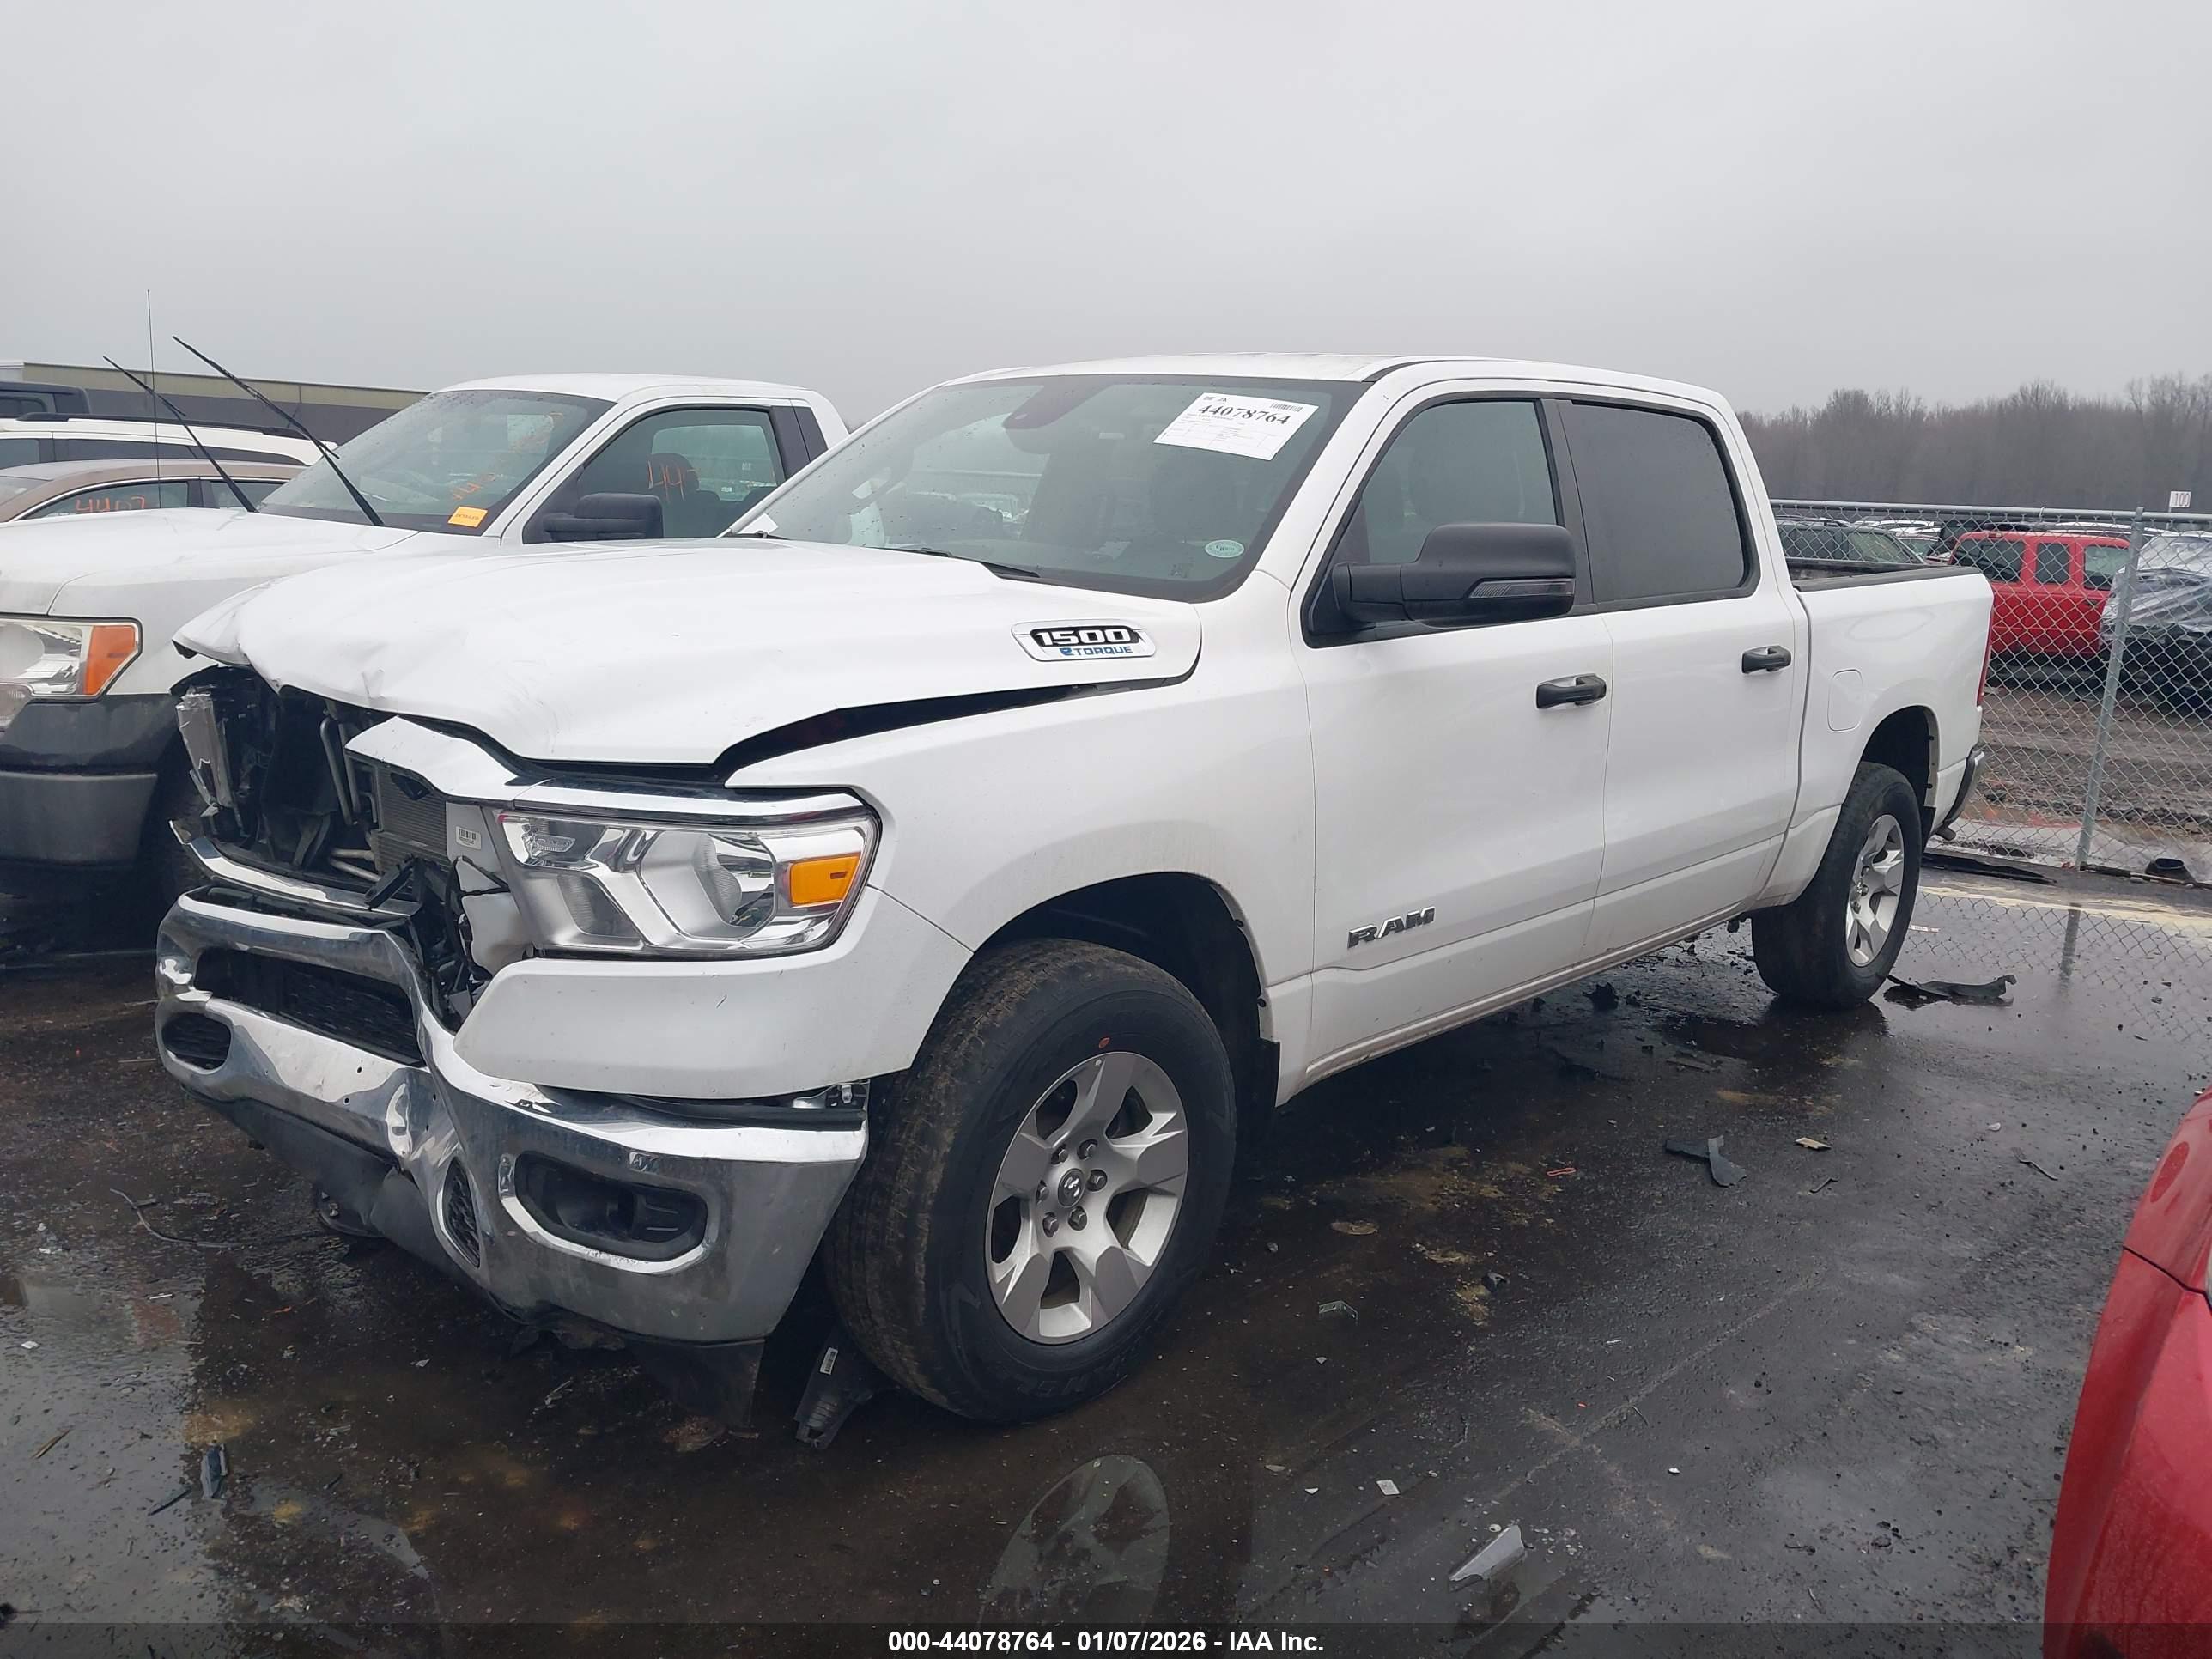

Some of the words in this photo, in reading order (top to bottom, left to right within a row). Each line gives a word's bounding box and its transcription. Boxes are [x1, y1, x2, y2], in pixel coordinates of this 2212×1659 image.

[1199, 404, 1291, 425] 44078764
[2175, 493, 2190, 507] 100
[1035, 629, 1131, 646] 1500
[1346, 906, 1435, 948] RAM
